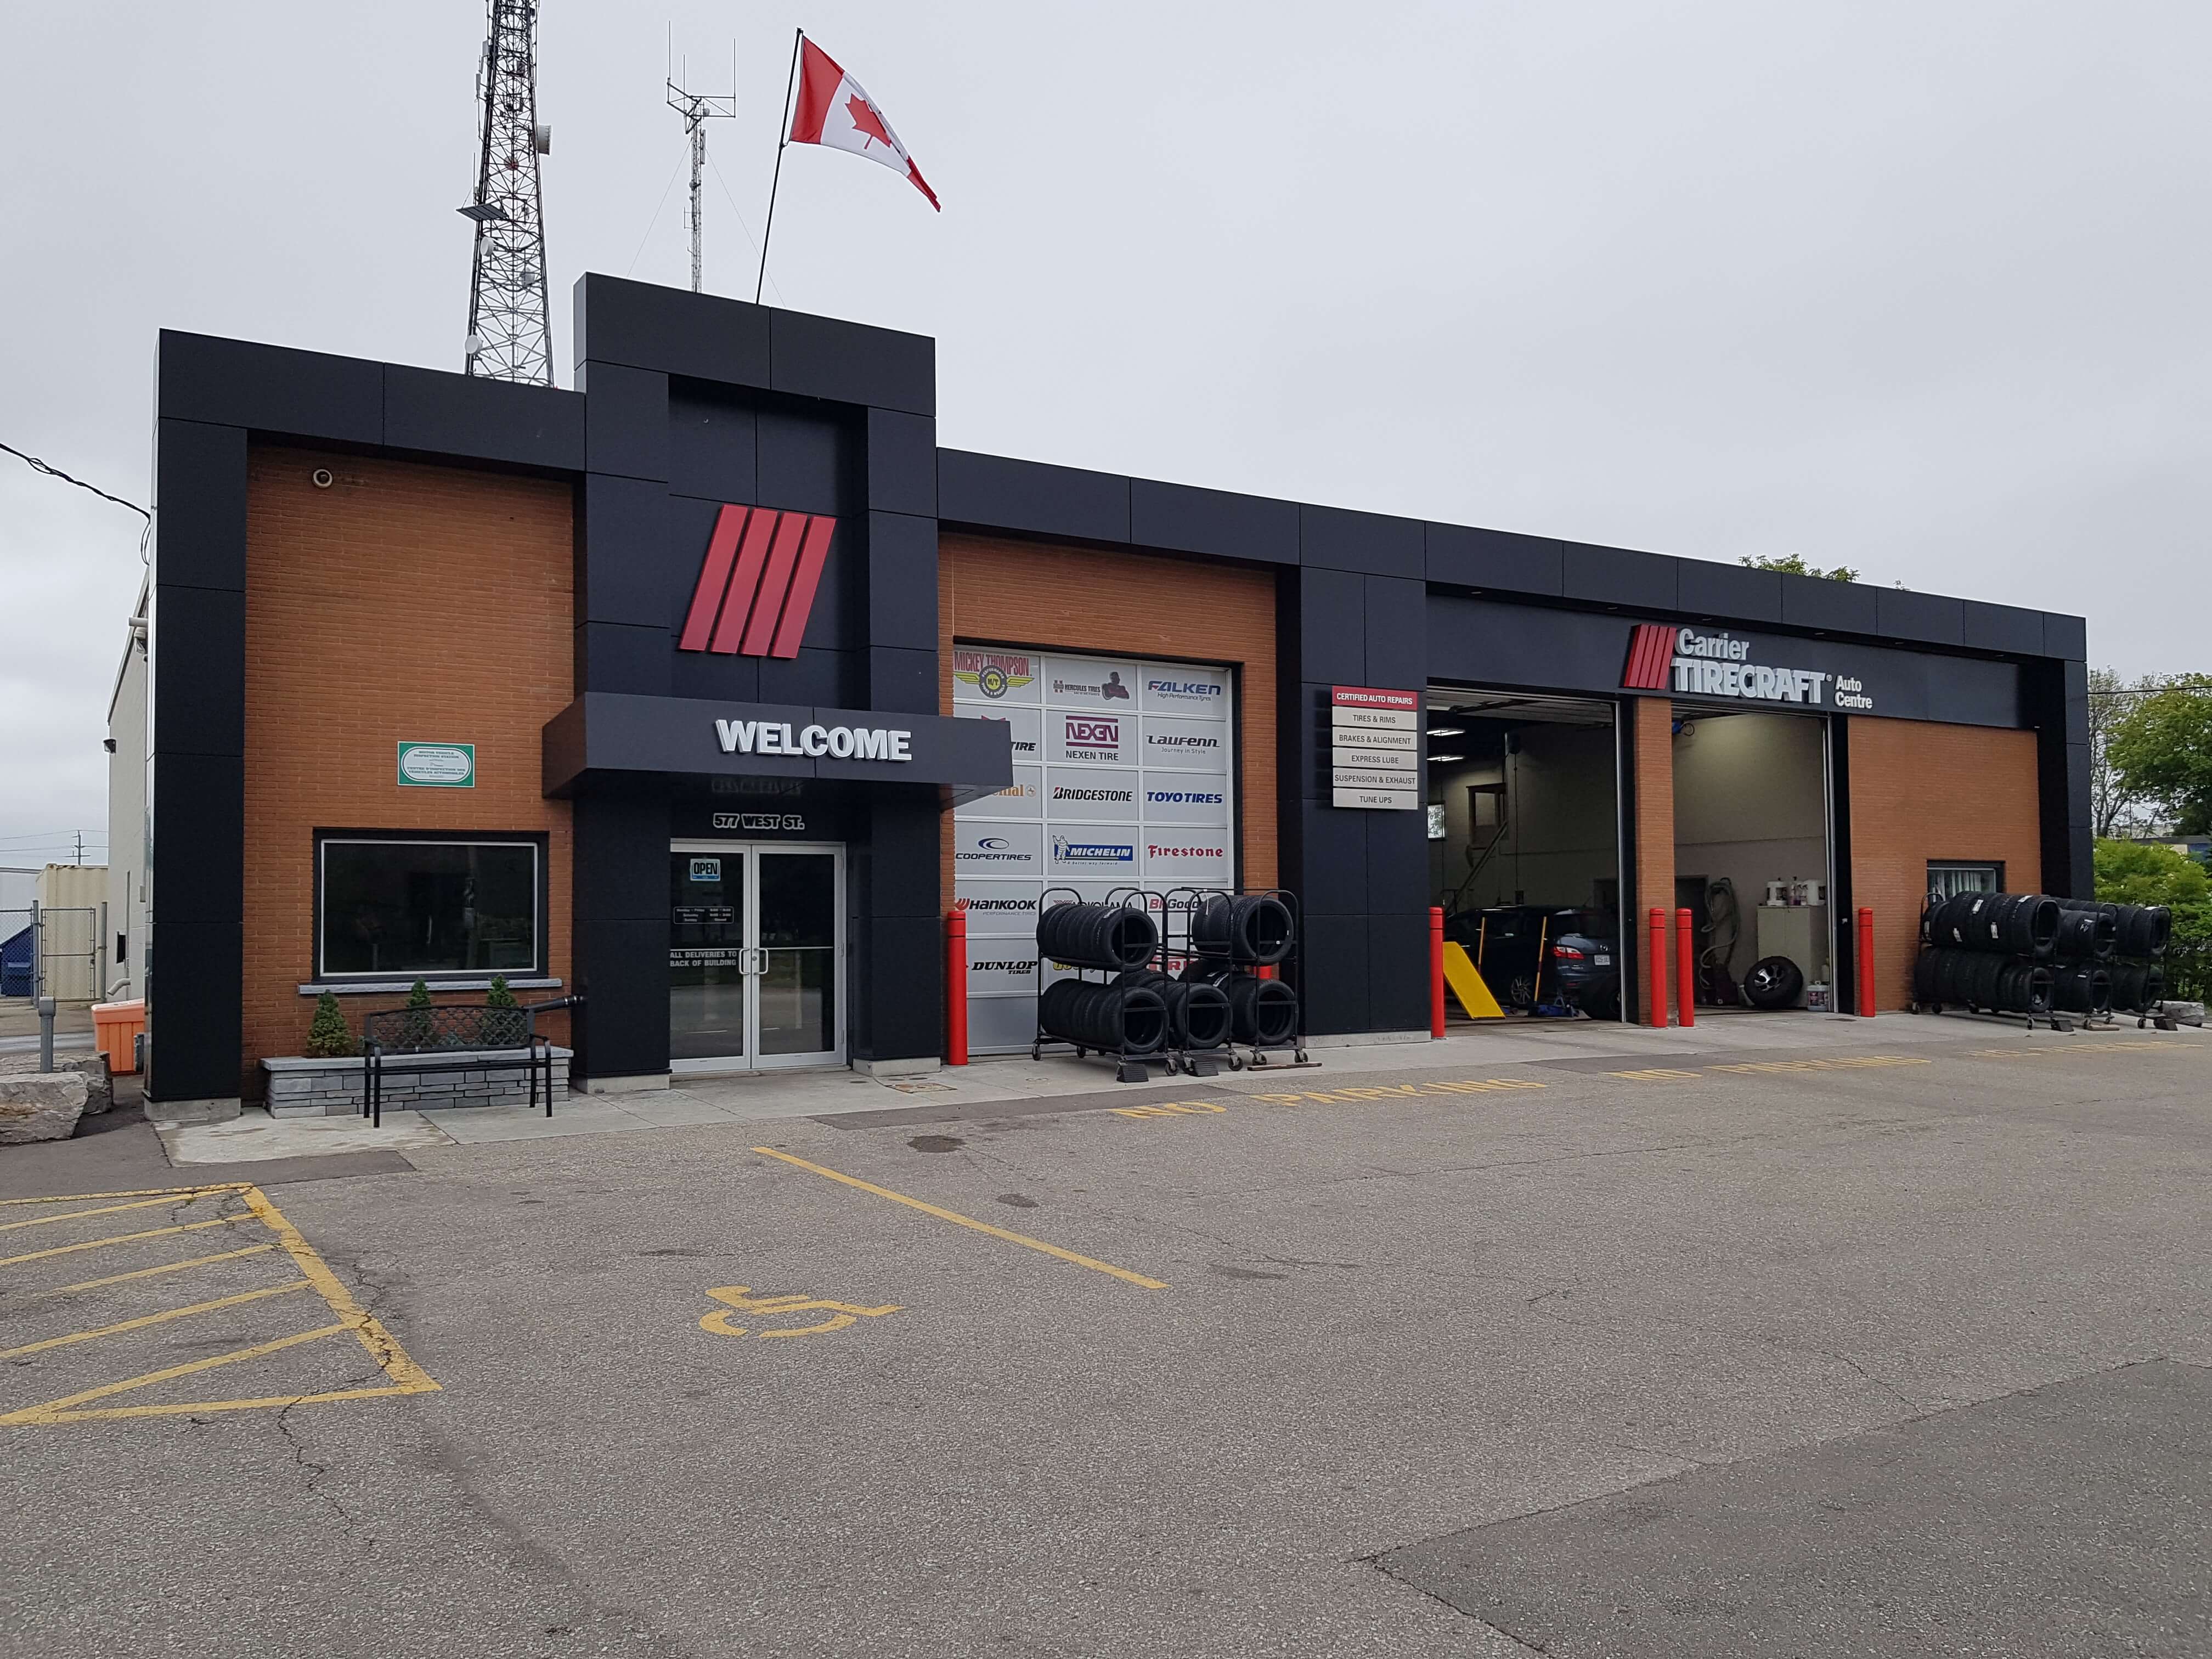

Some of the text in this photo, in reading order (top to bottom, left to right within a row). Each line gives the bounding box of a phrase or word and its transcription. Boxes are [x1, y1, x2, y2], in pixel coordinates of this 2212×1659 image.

[1675, 628, 1750, 661] Carrier
[954, 651, 1029, 676] MICKEY THOMPSON
[1671, 657, 1826, 703] TIRECRAFT
[1835, 675, 1862, 691] Auto
[1148, 681, 1221, 696] FALKEN
[1336, 693, 1368, 702] CERTIFIED
[1387, 696, 1413, 705] REPAIRS
[1835, 691, 1873, 709] Centre
[1353, 714, 1371, 723] TIRES
[1379, 715, 1396, 724] RIMS
[1066, 723, 1119, 742] NEXEN
[1339, 734, 1365, 742] BRAKES
[1373, 737, 1412, 745] ALIGNMENT
[715, 719, 912, 762] WELCOME
[1066, 750, 1119, 760] NEXEN TIRE
[1351, 755, 1381, 763] EXPRESS
[1335, 774, 1377, 783] SUSPENSION
[1385, 776, 1416, 785] EXHAUST
[1053, 787, 1133, 802] BRIDGESTONE
[1147, 792, 1223, 804] TOYO TIRES
[713, 813, 805, 830] 577 WEST ST.
[1070, 848, 1131, 856] MICHELIN
[1148, 844, 1224, 859] Firestone
[693, 862, 717, 874] OPEN
[972, 961, 1037, 970] DUNLOP
[1703, 1056, 1932, 1074] PARKING
[1107, 1079, 1548, 1119] NO PARKING
